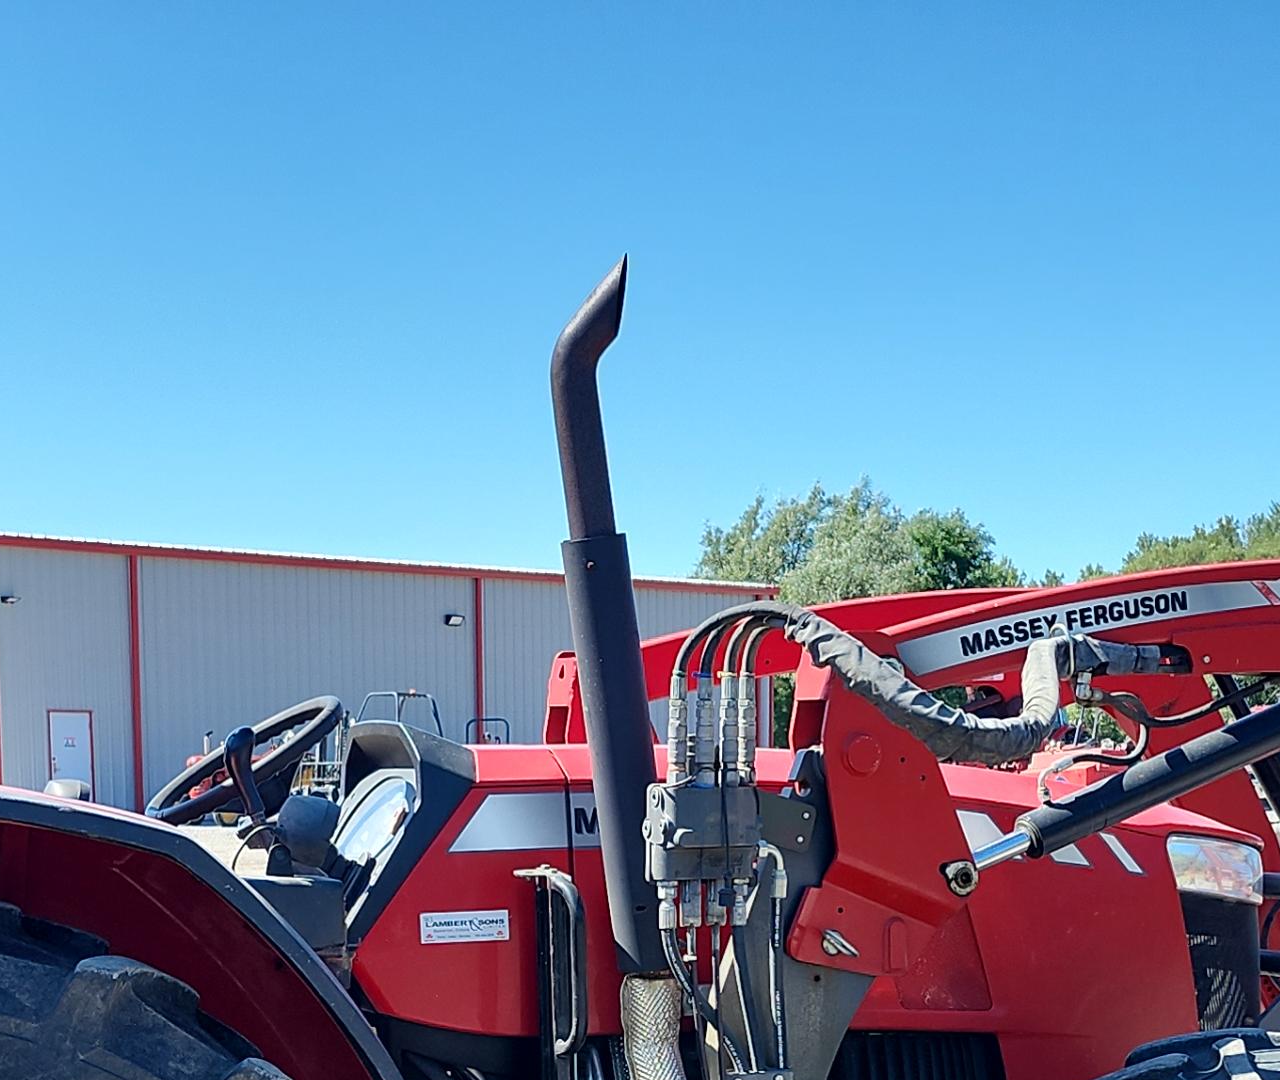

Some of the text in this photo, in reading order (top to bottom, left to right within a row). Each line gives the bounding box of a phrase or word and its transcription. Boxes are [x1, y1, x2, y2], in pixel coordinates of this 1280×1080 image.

[959, 589, 1189, 657] MASSEY FERGUSON
[425, 919, 473, 928] LAMBERT
[478, 918, 505, 926] SONS
